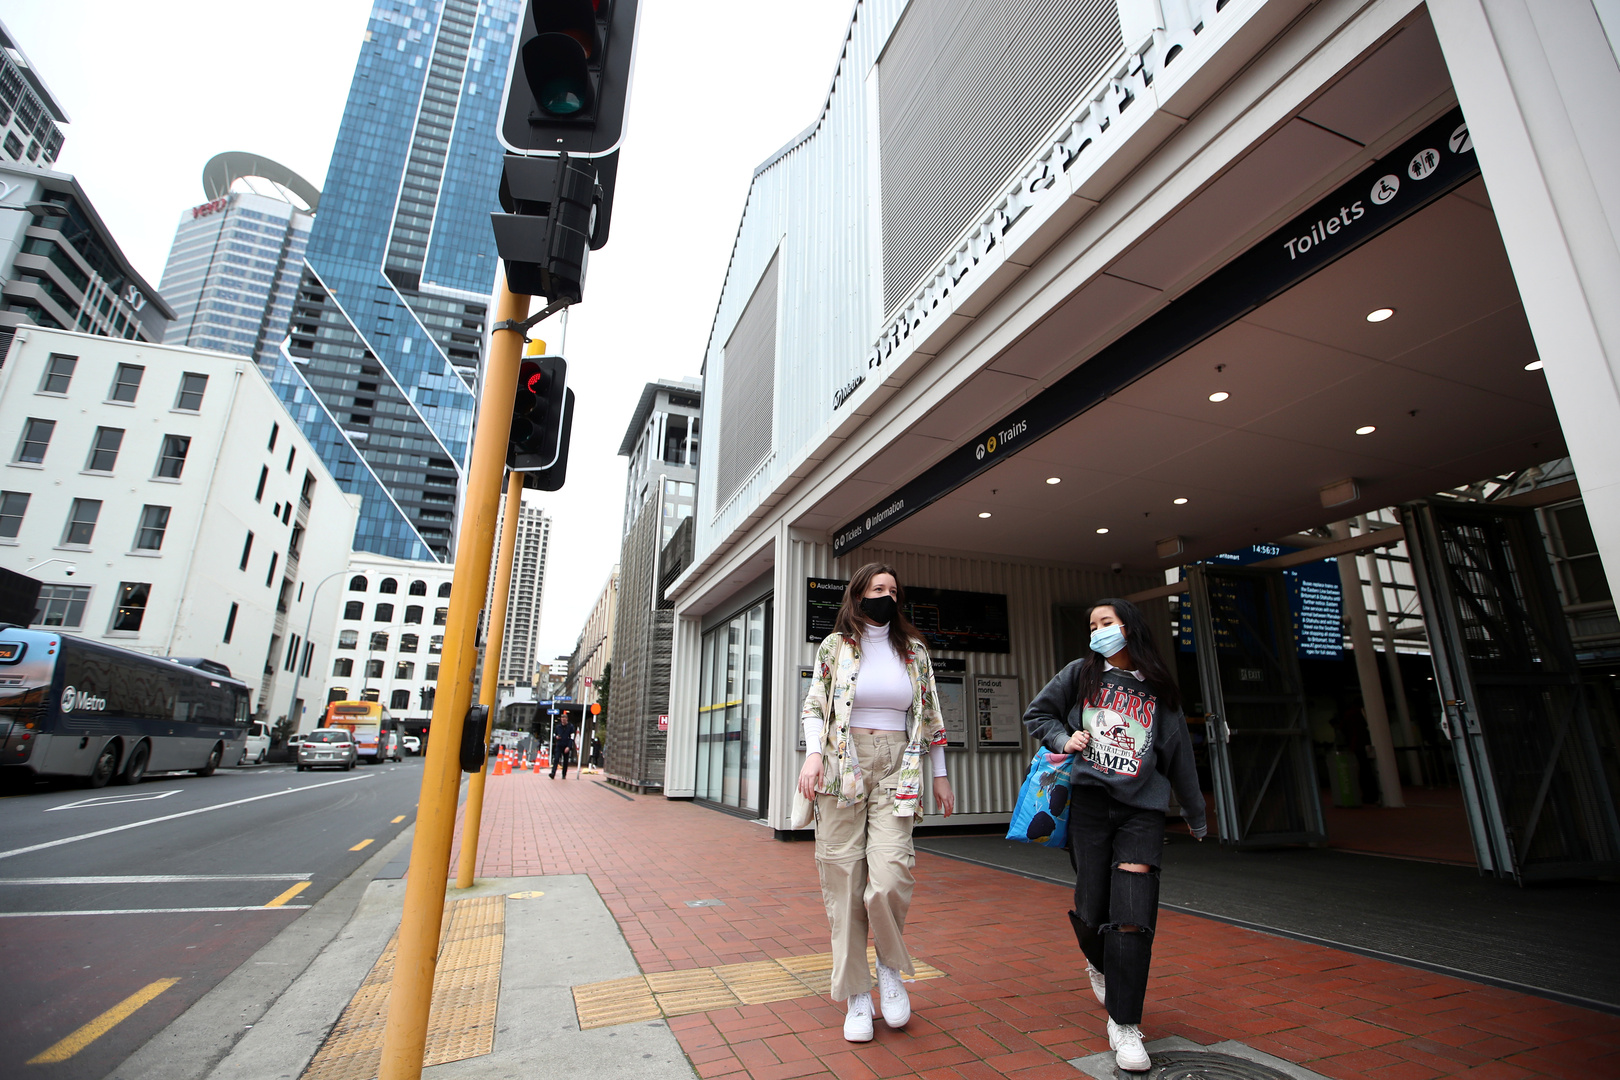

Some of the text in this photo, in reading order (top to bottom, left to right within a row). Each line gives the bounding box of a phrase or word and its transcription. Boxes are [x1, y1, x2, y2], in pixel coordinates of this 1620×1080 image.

[1283, 200, 1365, 261] Toilets
[998, 419, 1028, 445] Trains
[845, 499, 904, 543] Tickets Information
[1252, 544, 1280, 556] 14:56:37
[816, 582, 844, 591] Auckland
[1248, 670, 1261, 680] EXIT
[75, 690, 106, 711] Metro
[1083, 688, 1155, 729] ILERS
[661, 716, 668, 724] H
